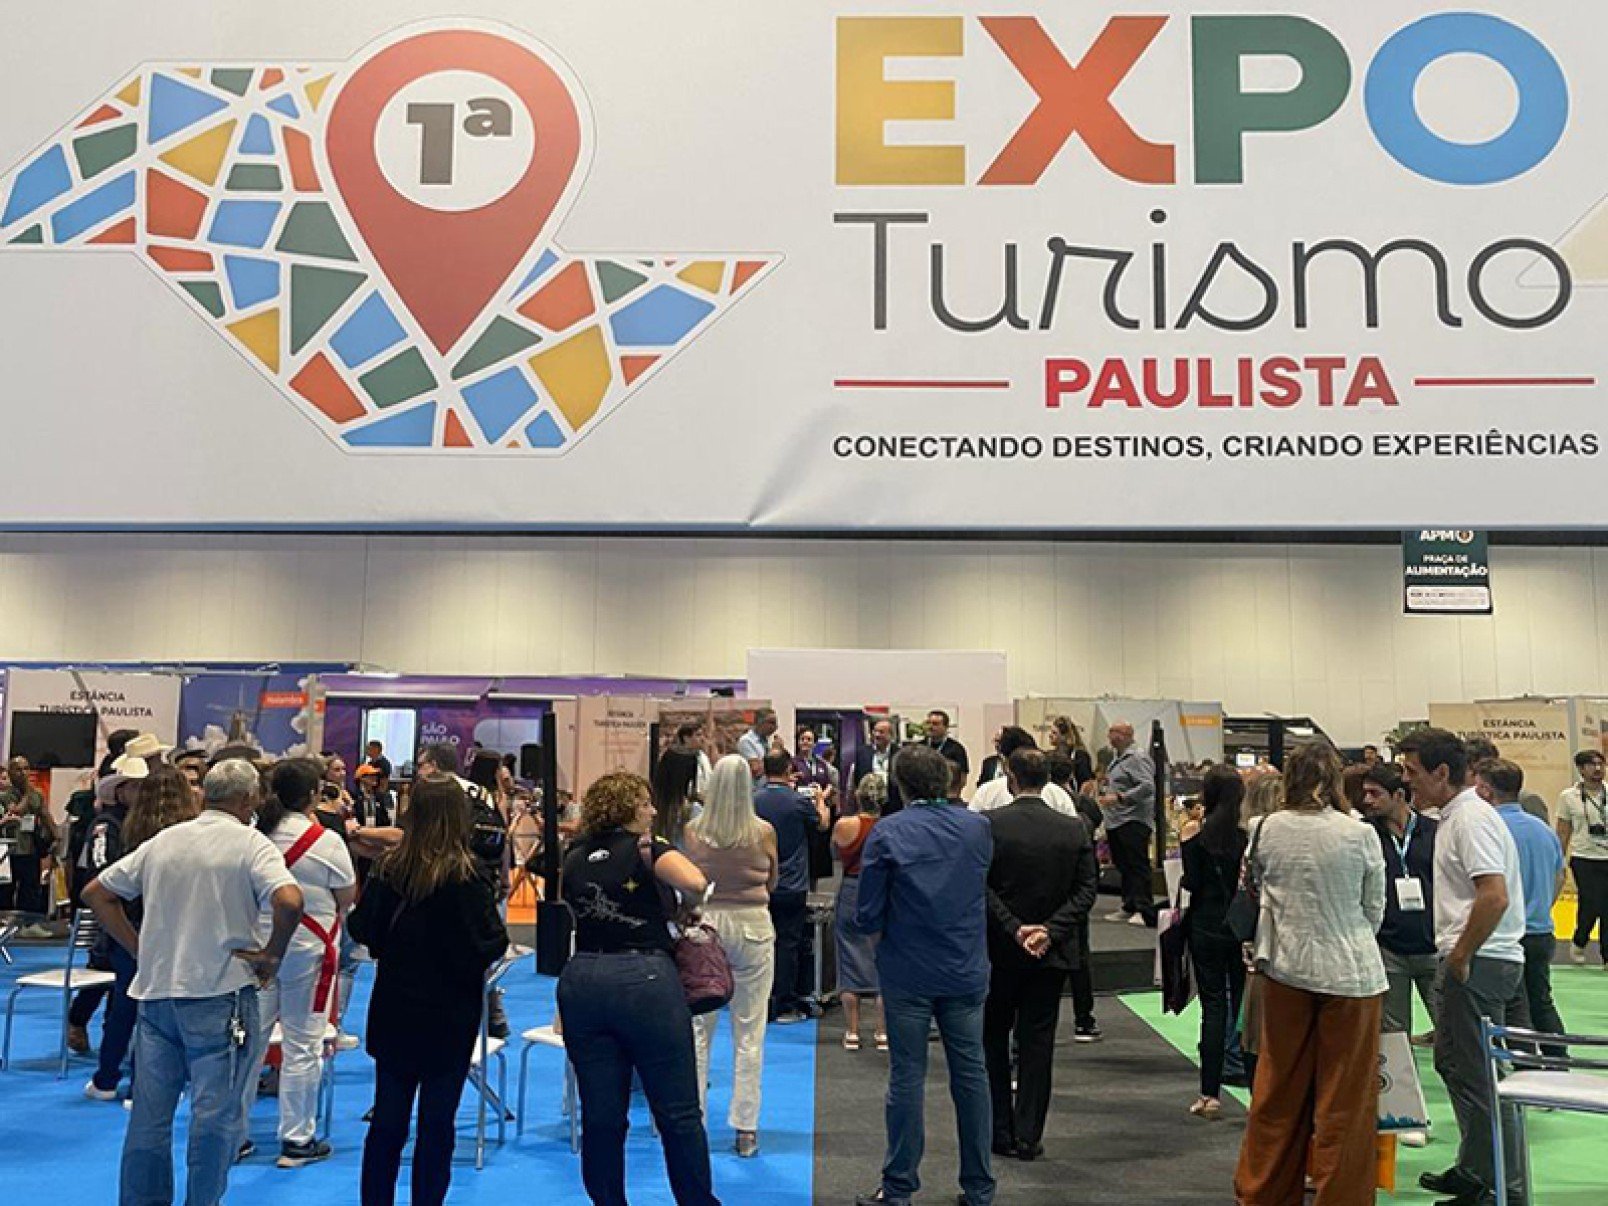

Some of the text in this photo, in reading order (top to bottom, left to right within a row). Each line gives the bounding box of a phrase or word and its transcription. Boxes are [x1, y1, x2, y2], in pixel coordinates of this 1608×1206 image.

[834, 12, 1569, 186] EXPO
[833, 209, 1572, 332] Turismo
[1044, 357, 1399, 408] PAULISTA
[833, 429, 1599, 460] CONECTANDO DESTINOS, CRIANDO EXPERIÊNCIAS
[70, 690, 125, 701] ESTÂNCIA
[101, 707, 153, 716] PAULISTA
[1483, 719, 1536, 728] ESTÂNCIA
[1513, 731, 1566, 740] PAULISTA
